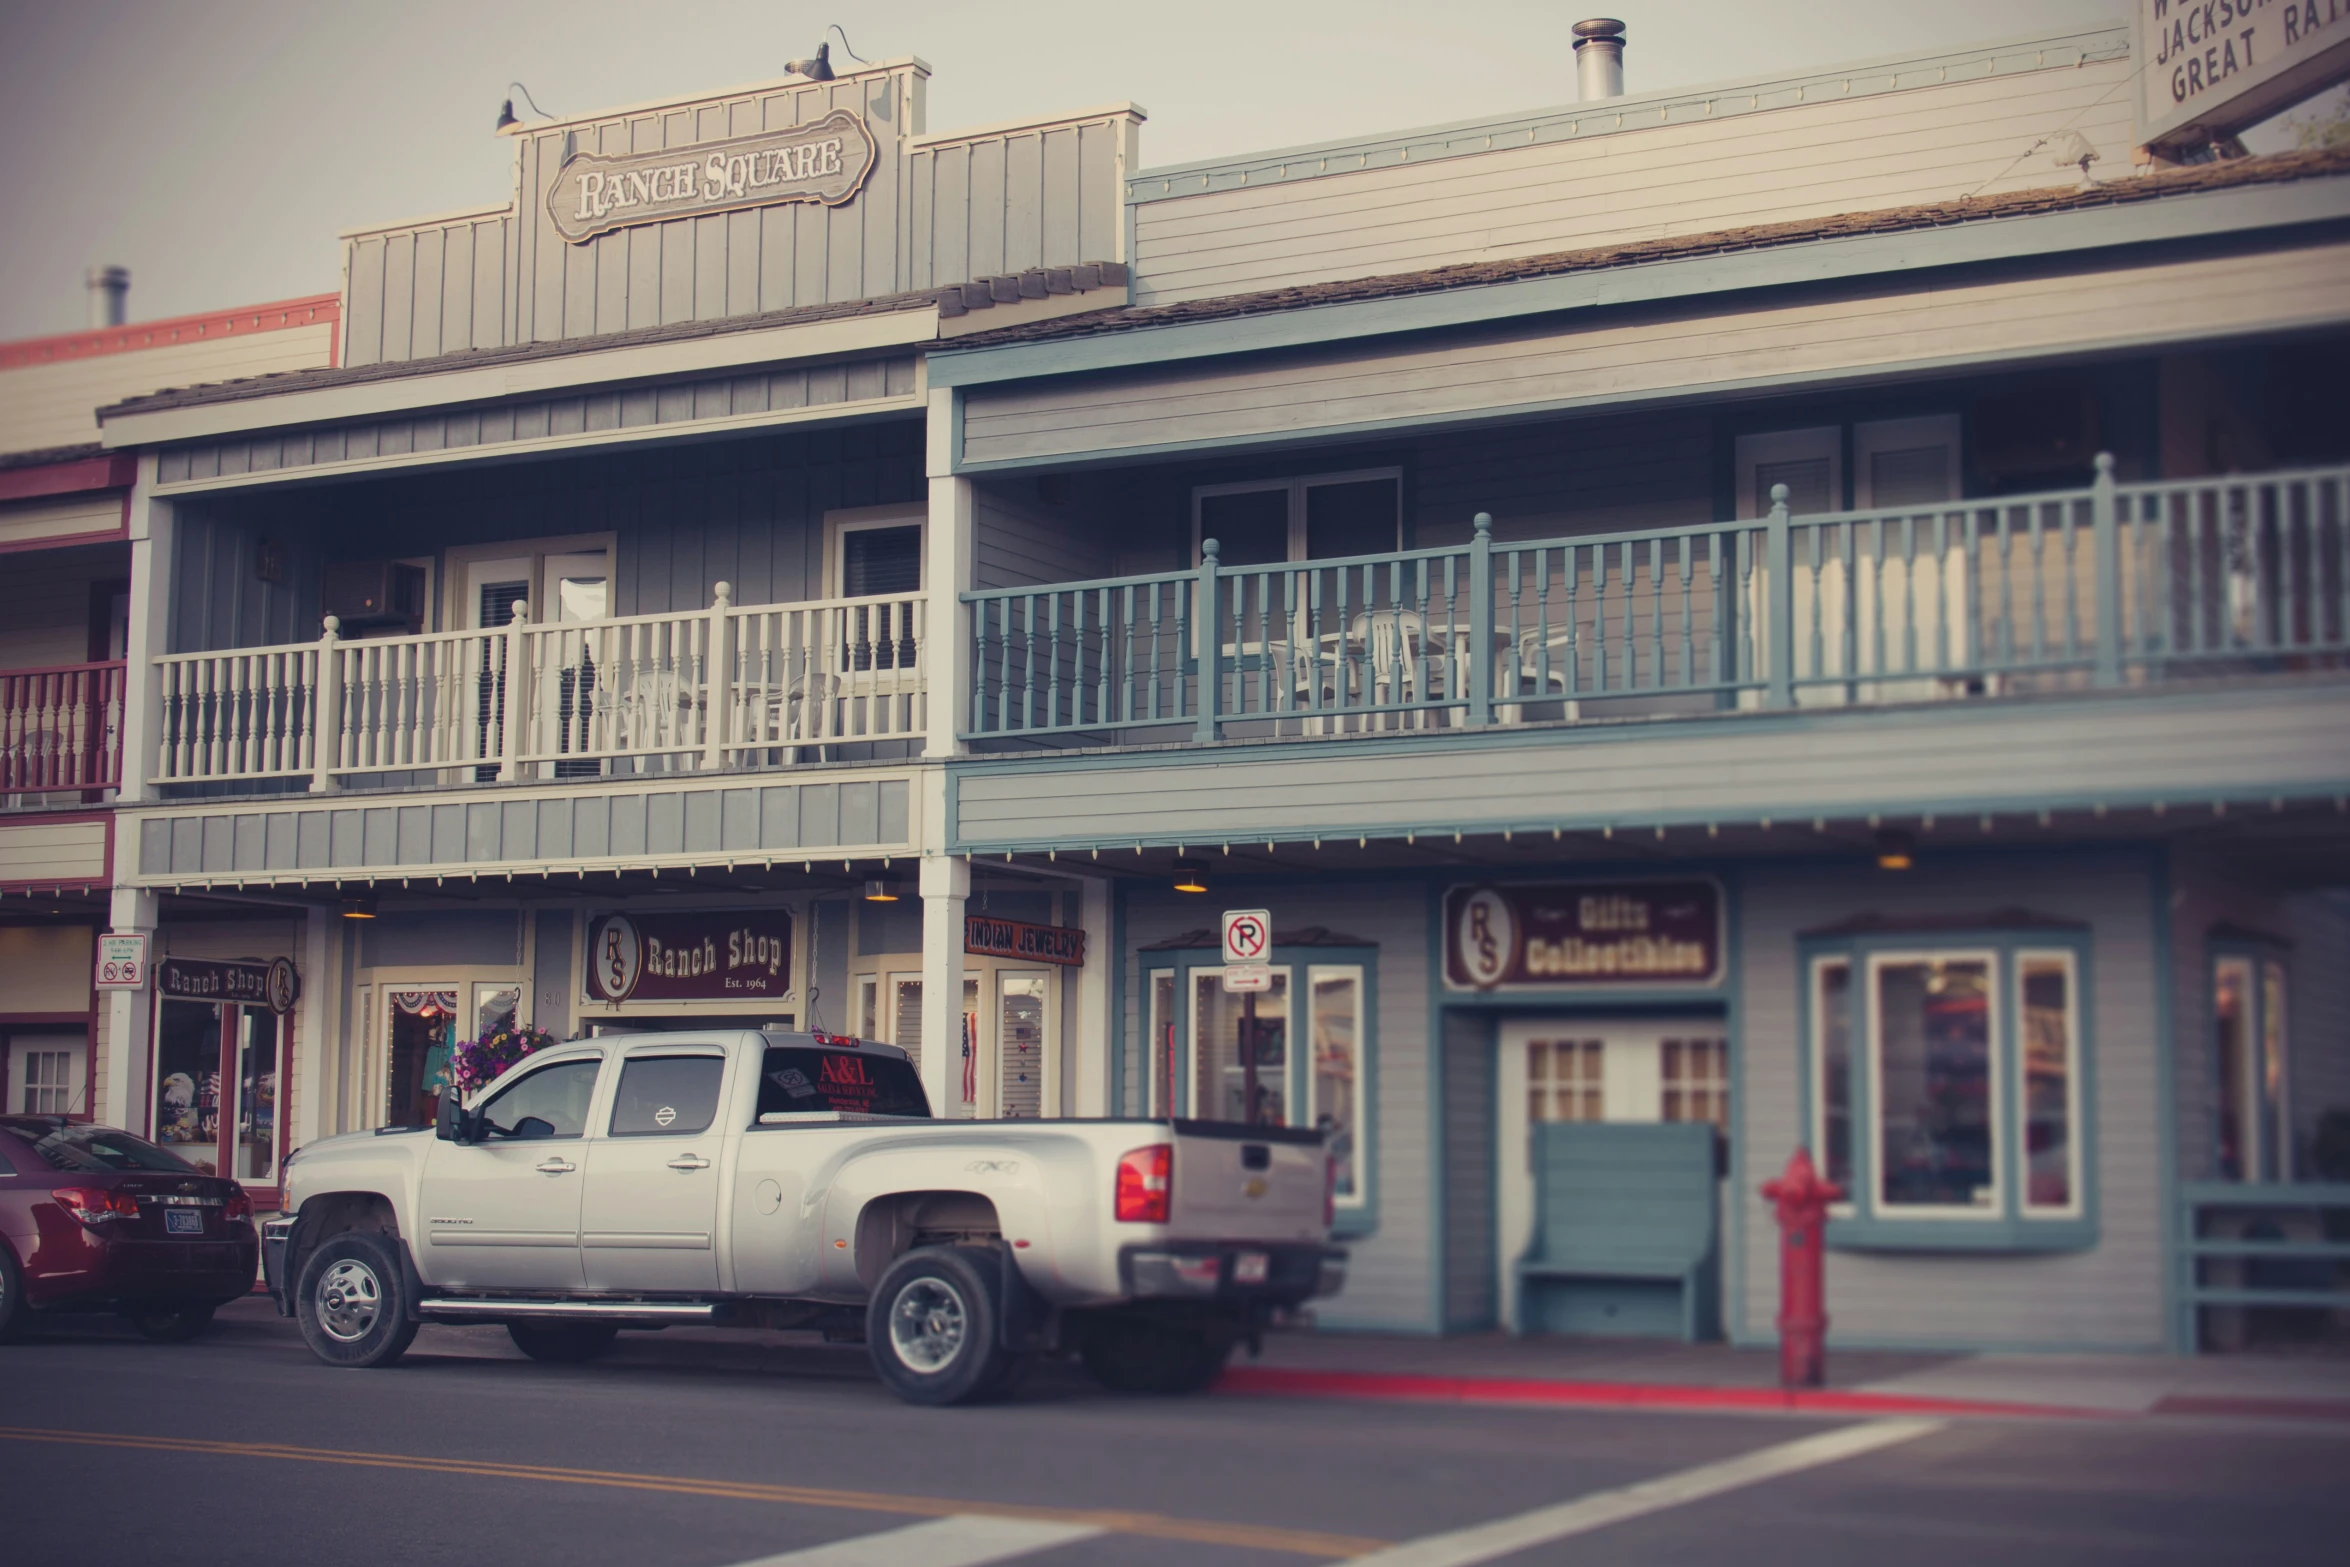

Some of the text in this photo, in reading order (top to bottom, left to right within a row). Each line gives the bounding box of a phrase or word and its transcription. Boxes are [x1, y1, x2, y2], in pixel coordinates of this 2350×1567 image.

[2157, 0, 2272, 65] JACKSO
[2171, 0, 2350, 103] GREAT RAT
[574, 137, 842, 221] RANCH SQUARE
[119, 939, 142, 947] PARKING
[648, 927, 782, 979] Ranch Shop
[969, 920, 1078, 960] INDIAN JEWELRY
[171, 968, 263, 996] Ranch Shop
[545, 991, 560, 1007] 80
[725, 977, 767, 989] Est. 1964
[820, 1055, 874, 1085] A&L
